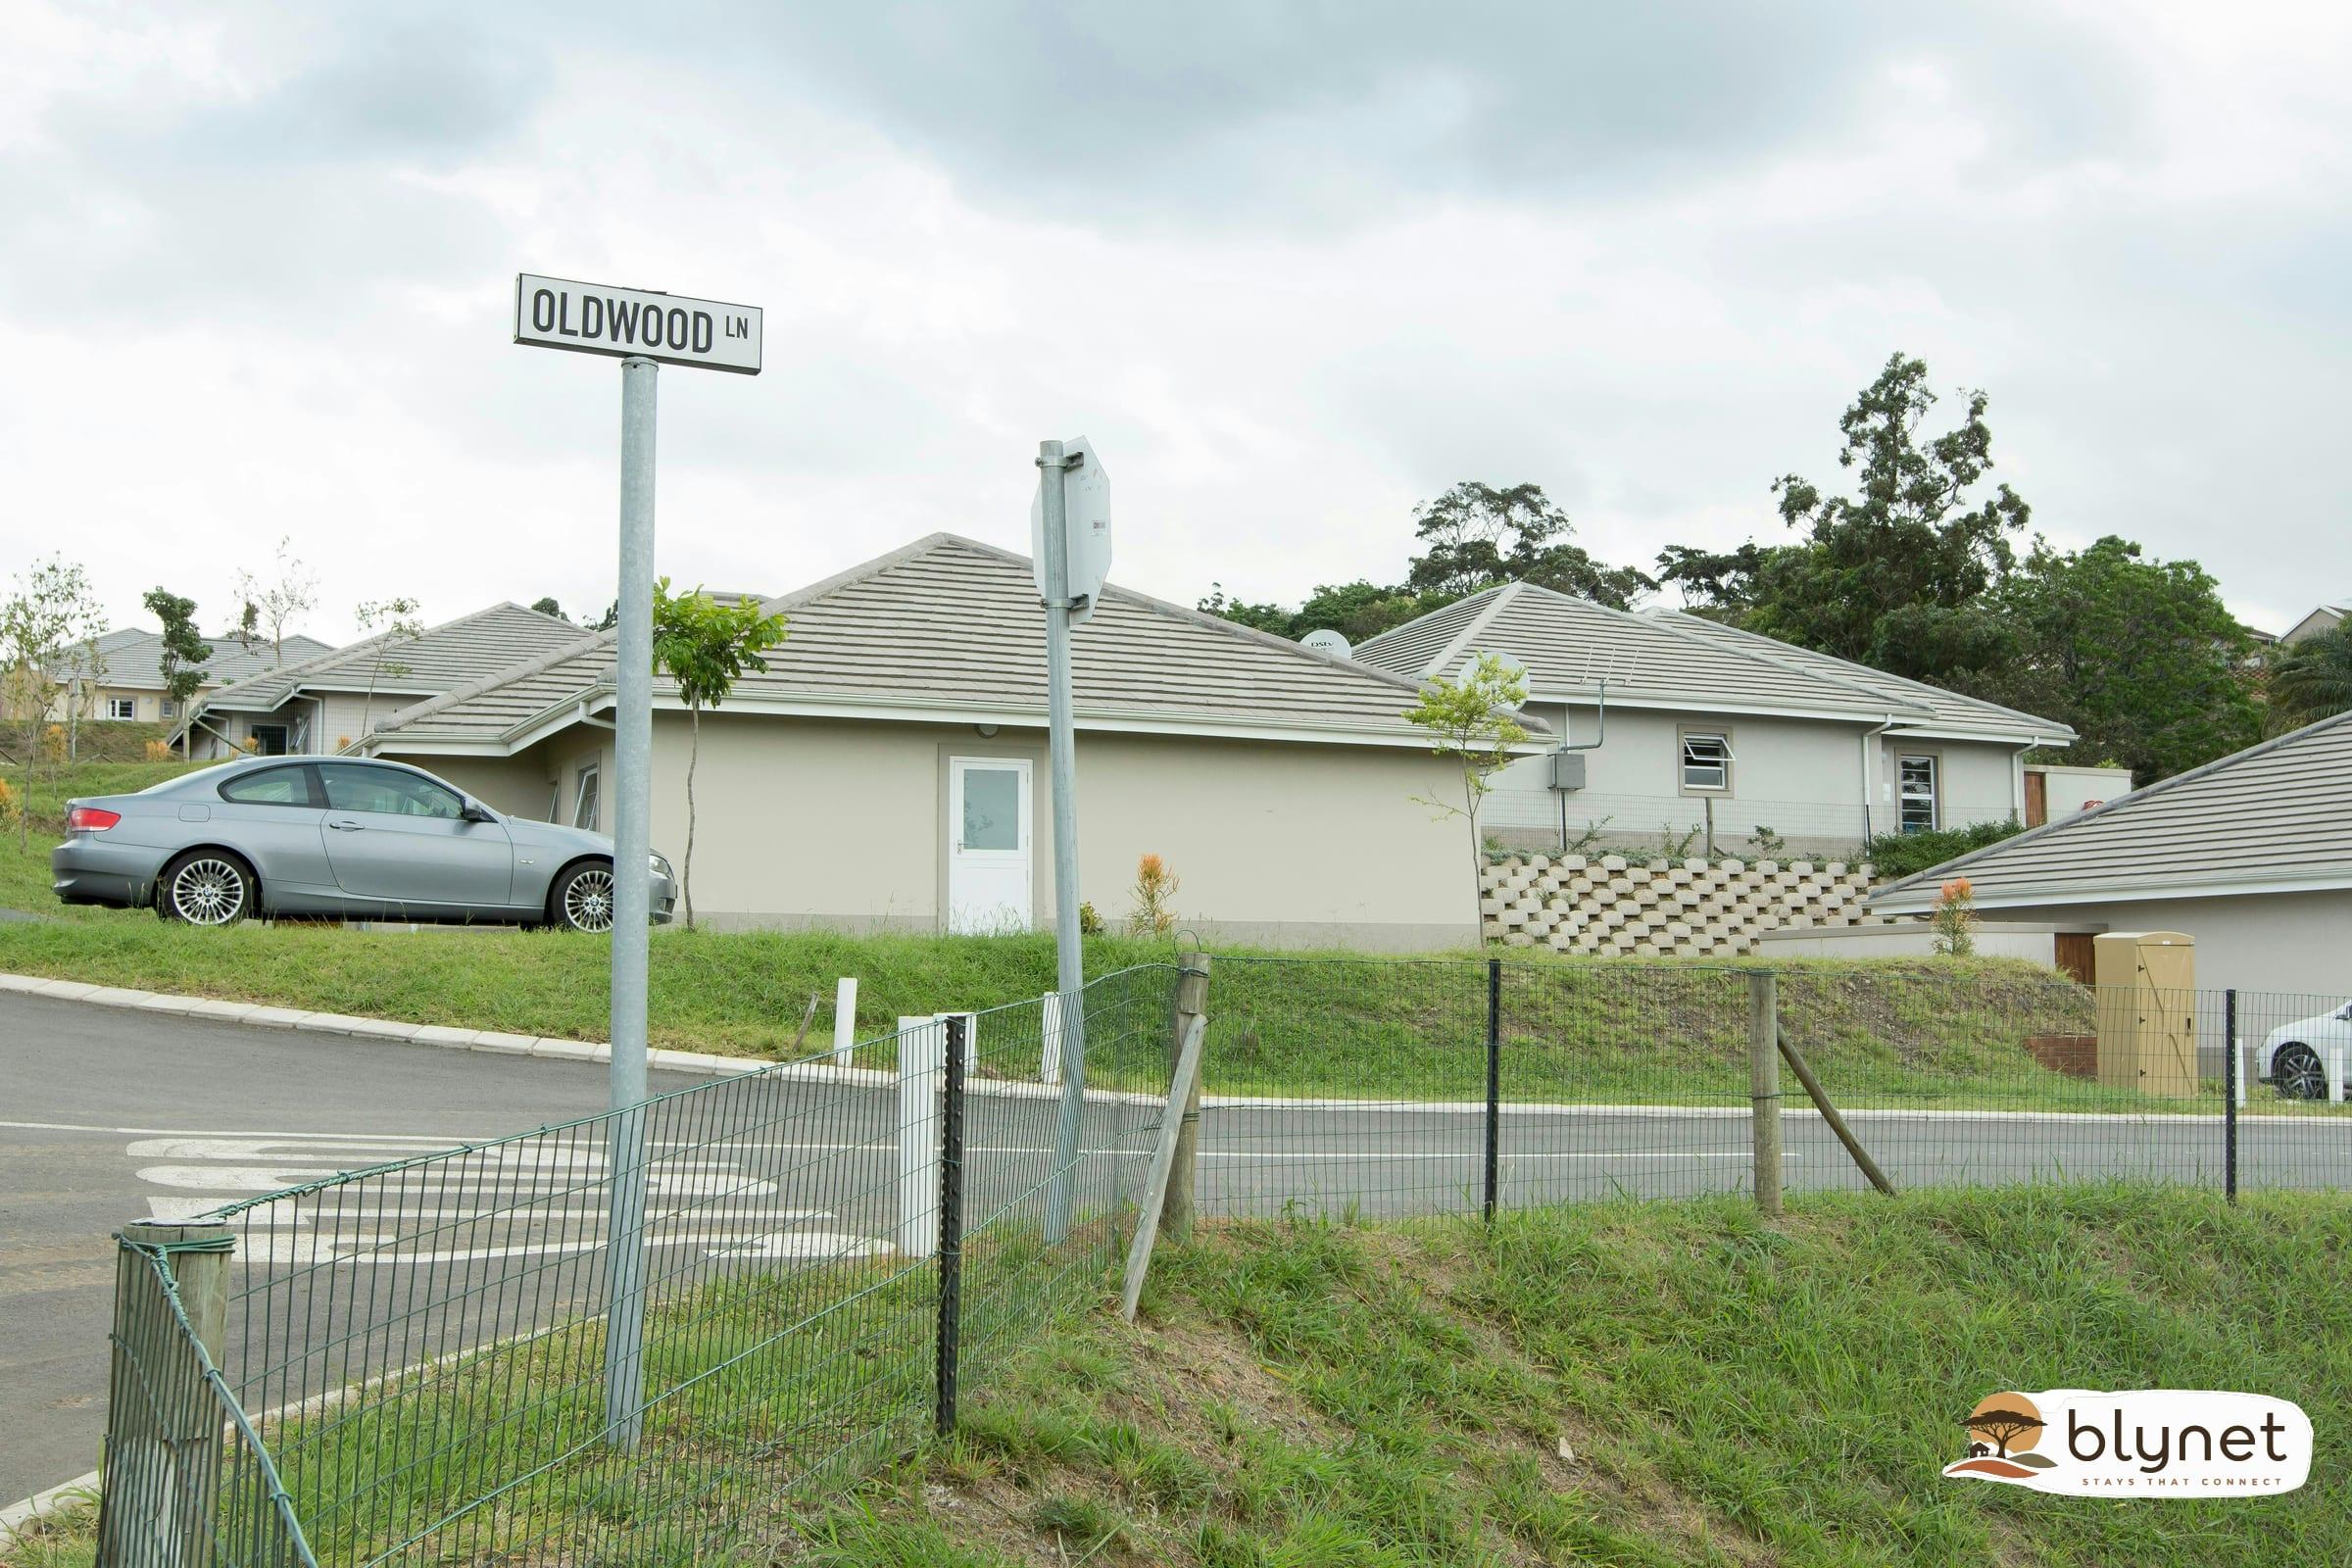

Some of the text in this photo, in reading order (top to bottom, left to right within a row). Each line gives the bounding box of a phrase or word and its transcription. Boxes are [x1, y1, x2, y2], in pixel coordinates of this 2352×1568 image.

[533, 288, 749, 354] OLDWOOD LN
[126, 1138, 896, 1263] STOP
